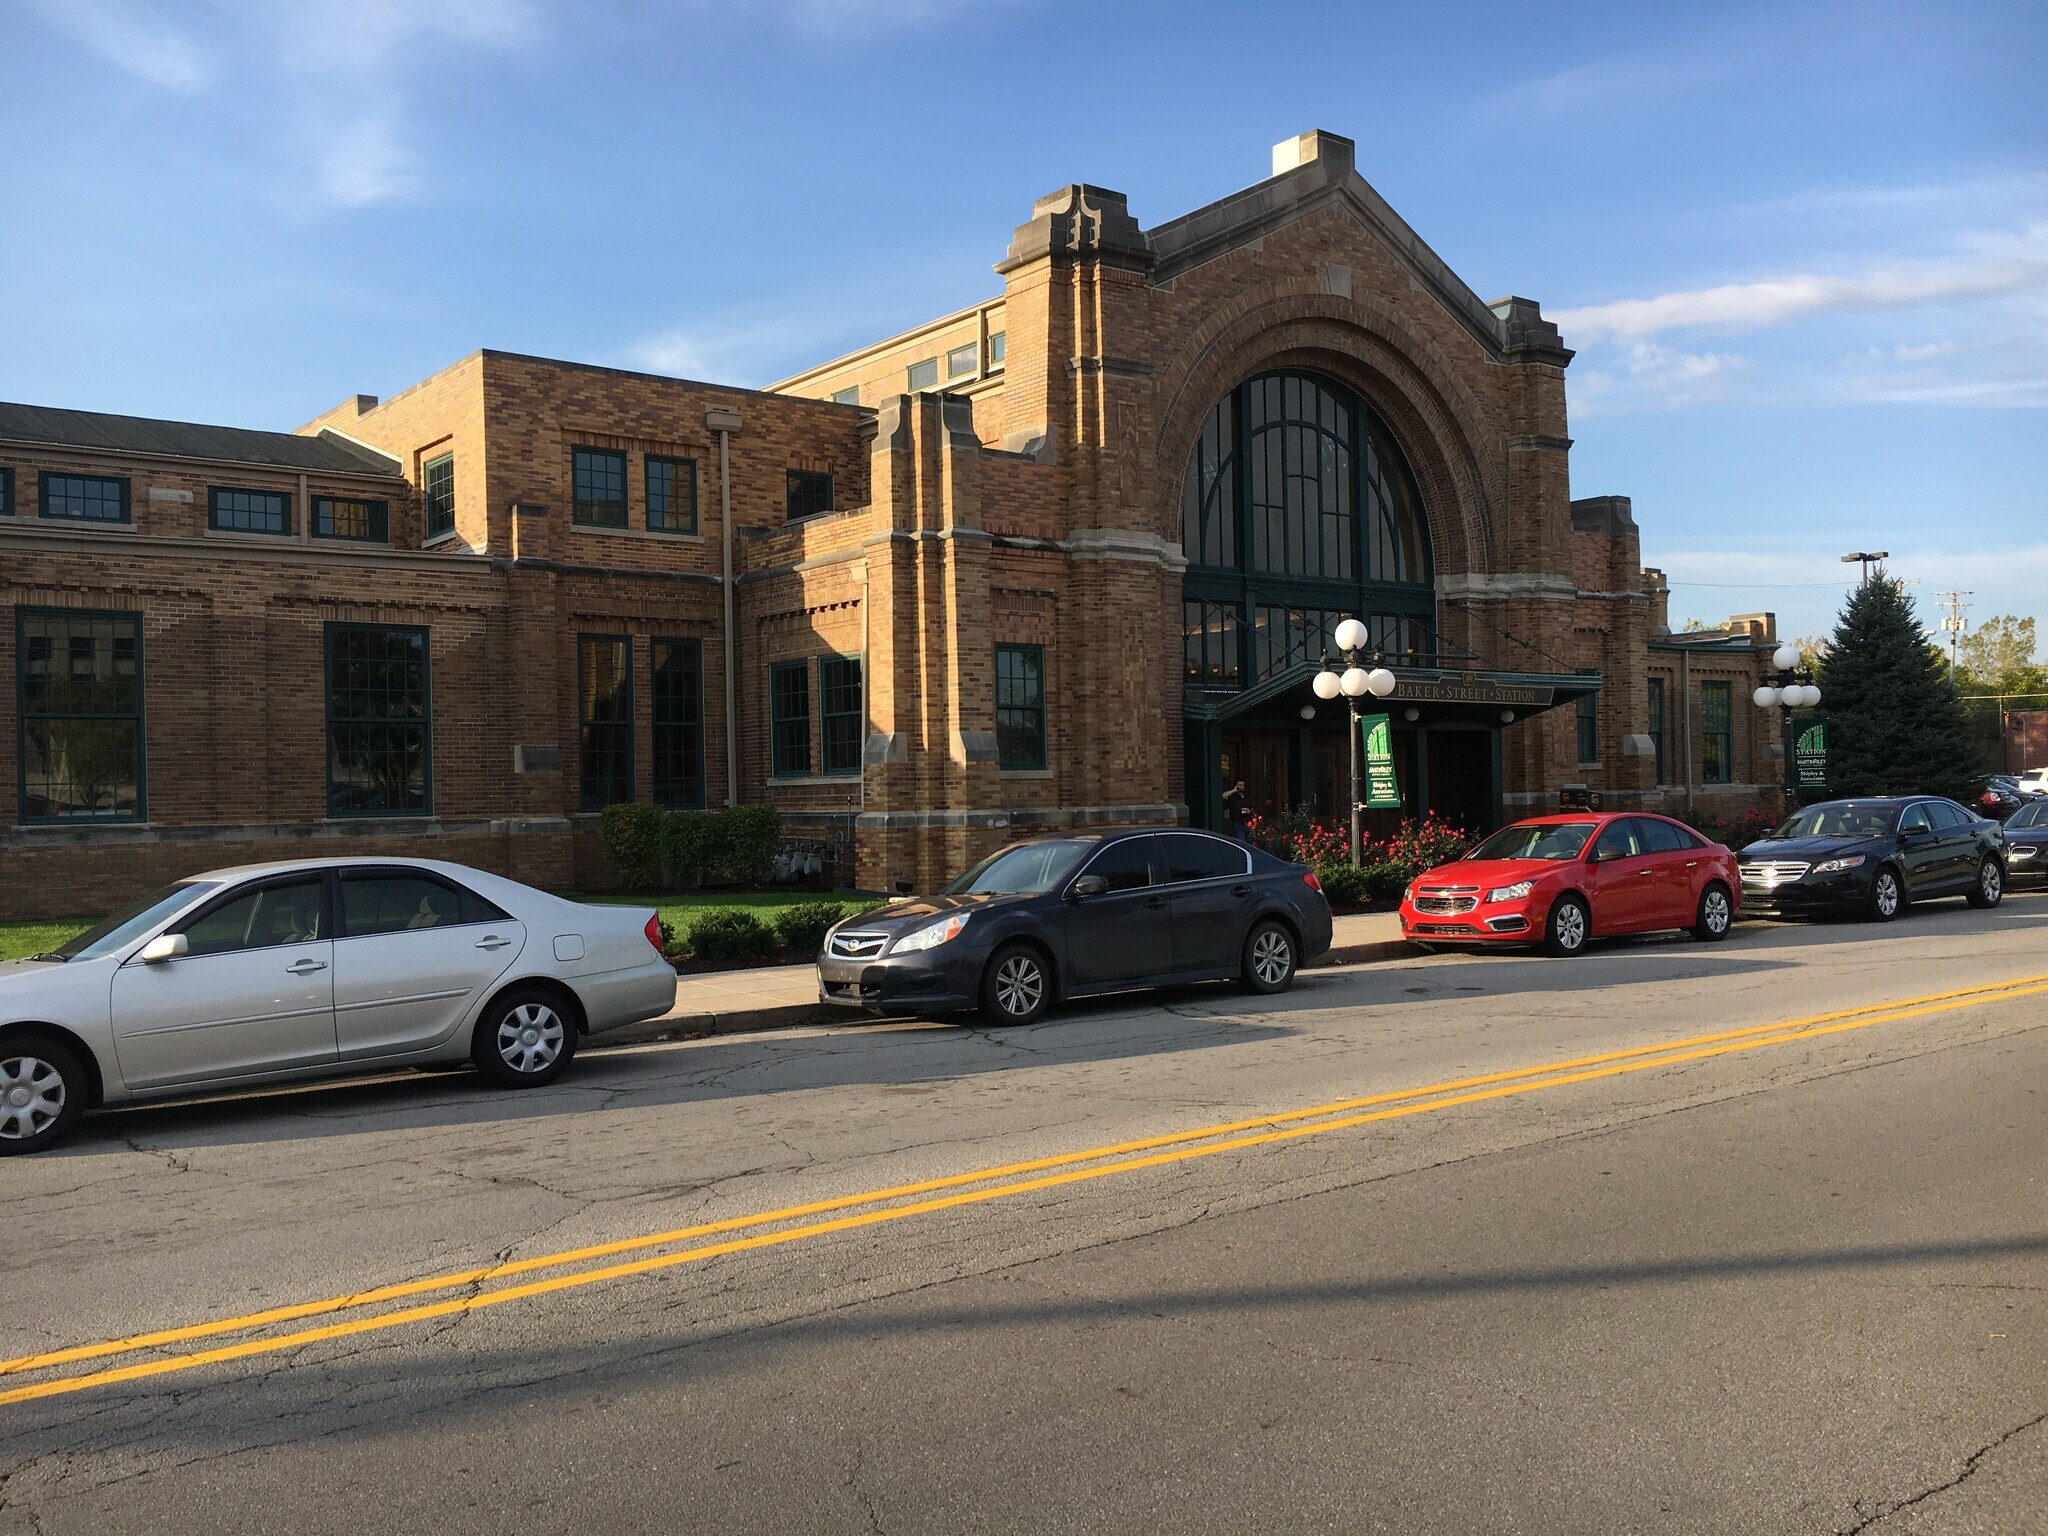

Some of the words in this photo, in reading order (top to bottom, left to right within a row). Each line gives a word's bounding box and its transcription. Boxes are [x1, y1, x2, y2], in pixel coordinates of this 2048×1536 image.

[1397, 683, 1440, 698] BAKER
[1446, 685, 1487, 700] STREET
[1495, 688, 1536, 702] STATION
